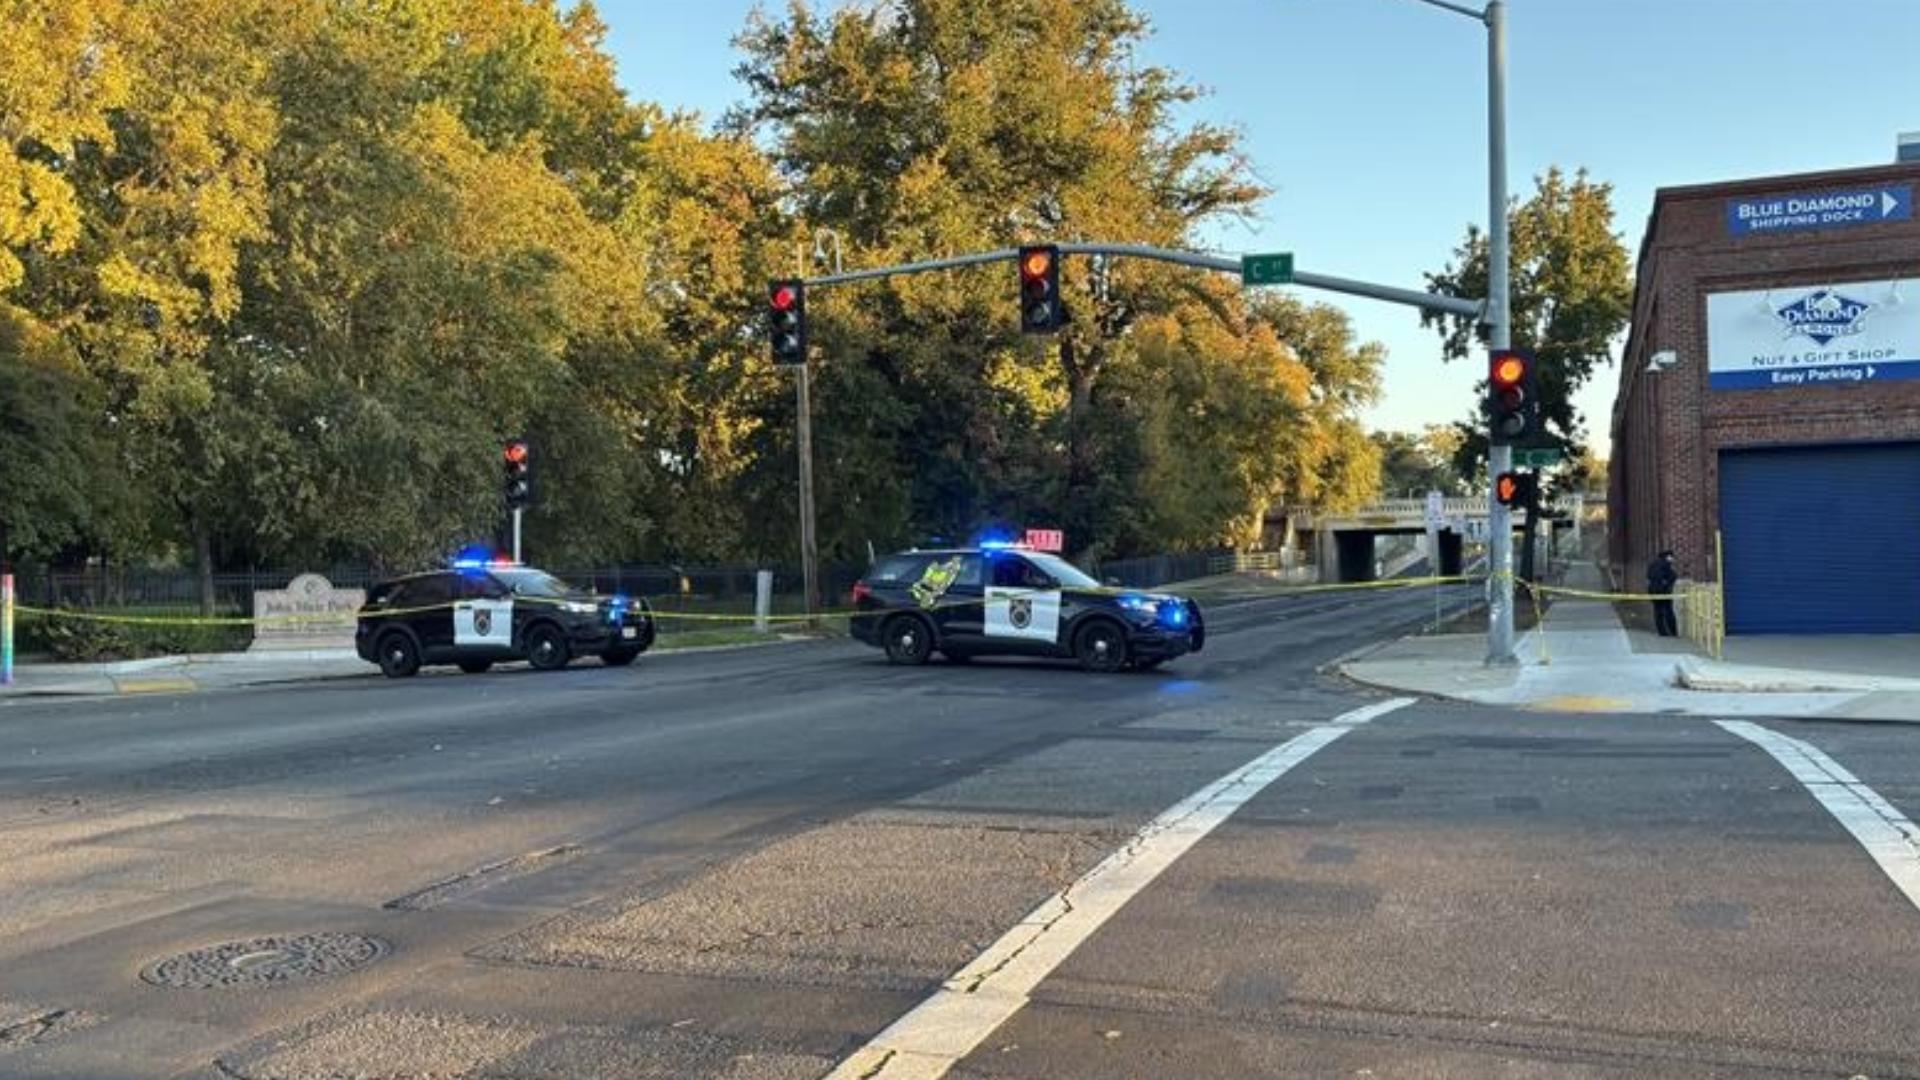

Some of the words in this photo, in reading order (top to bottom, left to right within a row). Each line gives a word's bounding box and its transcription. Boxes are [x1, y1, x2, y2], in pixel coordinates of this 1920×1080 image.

[1739, 202, 1783, 219] BLUE
[1788, 194, 1875, 215] DIAMOND
[1750, 214, 1818, 229] SHIPPING
[1822, 209, 1864, 223] DOCK
[1253, 262, 1264, 279] C
[1785, 305, 1862, 322] DIAMOND
[1752, 355, 1784, 366] NUT
[1791, 355, 1799, 364] &
[1803, 351, 1843, 363] GIFT
[1848, 349, 1897, 361] SHOP
[1771, 371, 1806, 384] Easy
[1808, 366, 1863, 381] Parking
